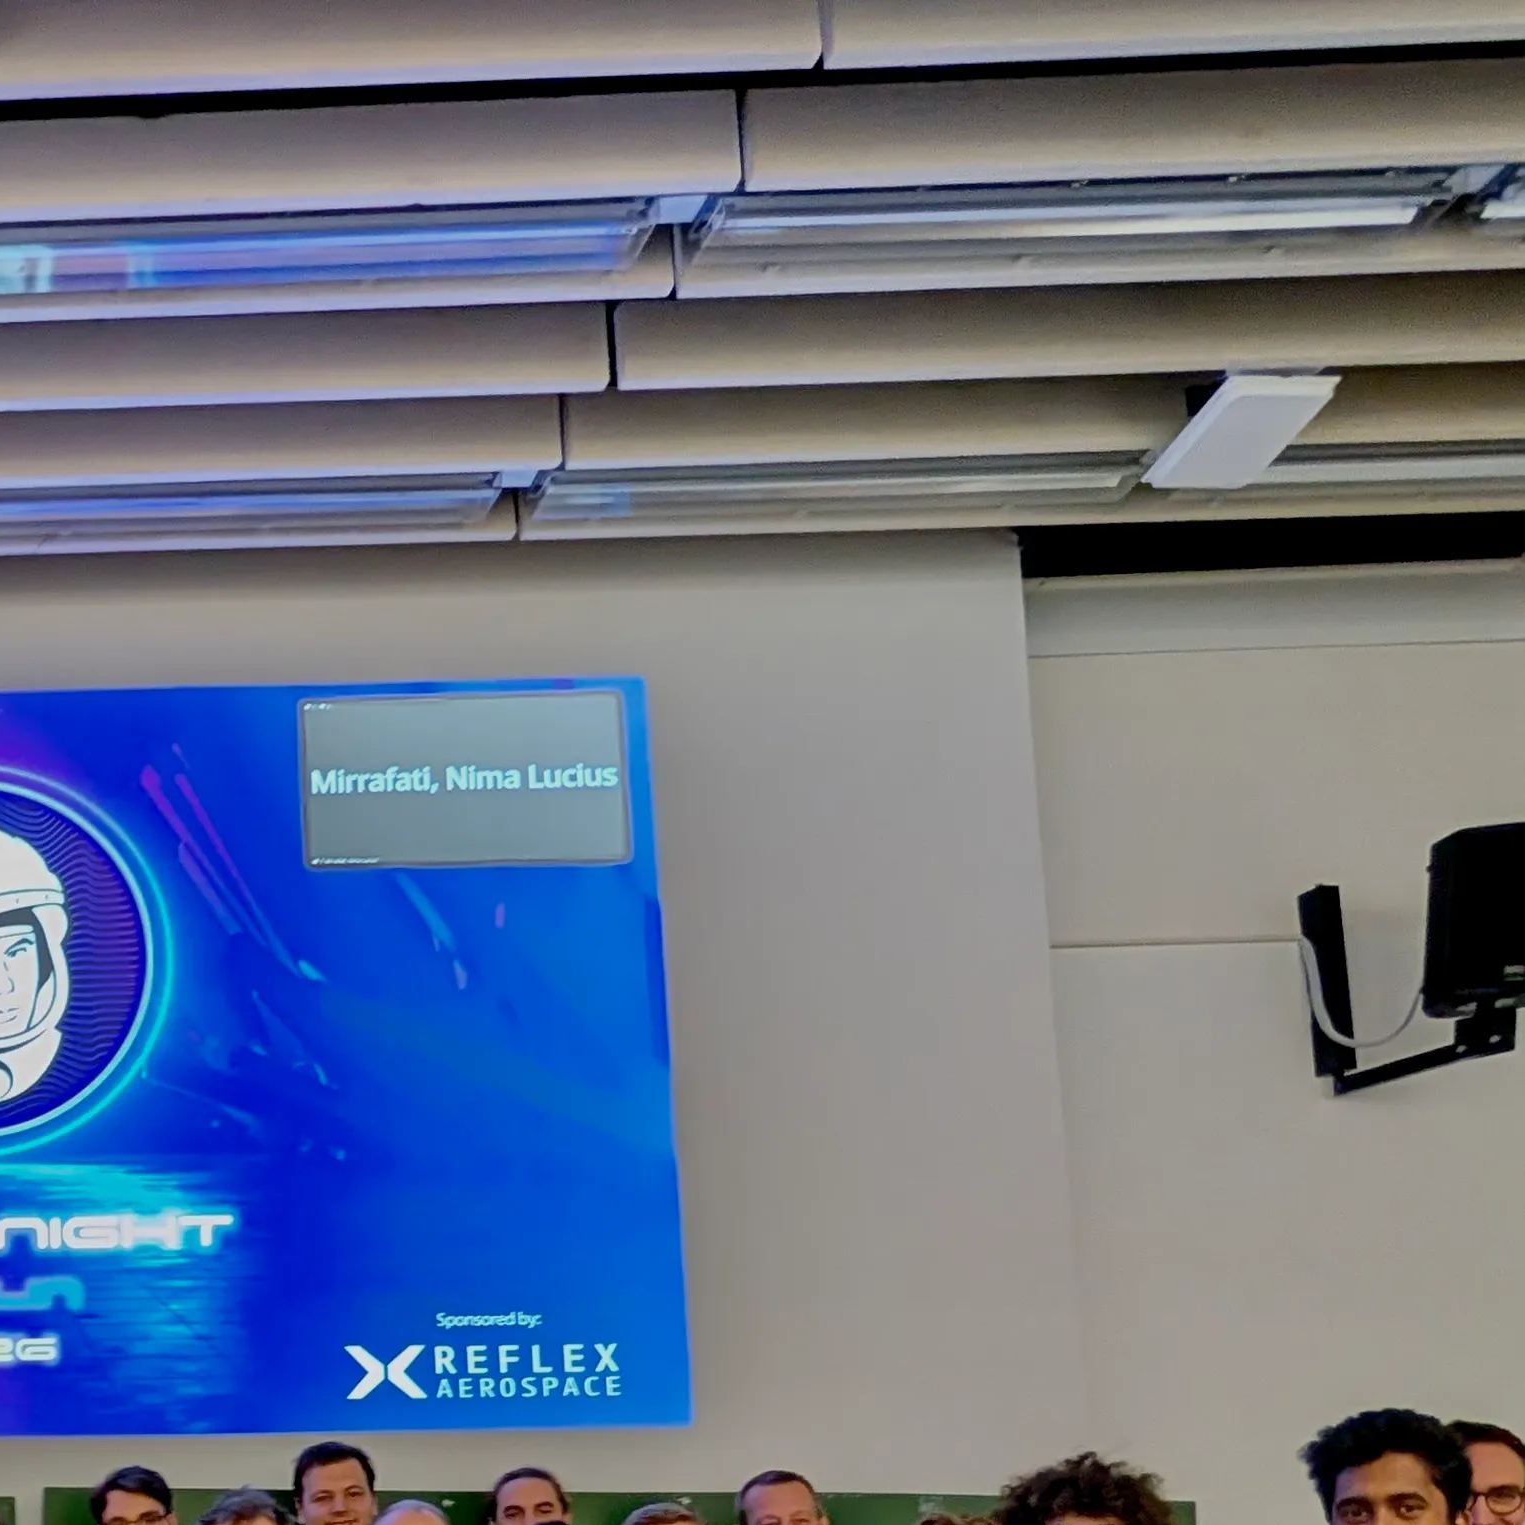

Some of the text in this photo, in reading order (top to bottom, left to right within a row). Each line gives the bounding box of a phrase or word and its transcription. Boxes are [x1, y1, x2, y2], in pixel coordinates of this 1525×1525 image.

[310, 762, 619, 795] Mirrafati, Nima Lucius
[435, 1311, 516, 1330] Sponsored
[434, 1342, 620, 1375] REFLEX
[435, 1375, 623, 1399] AEROSPACE
